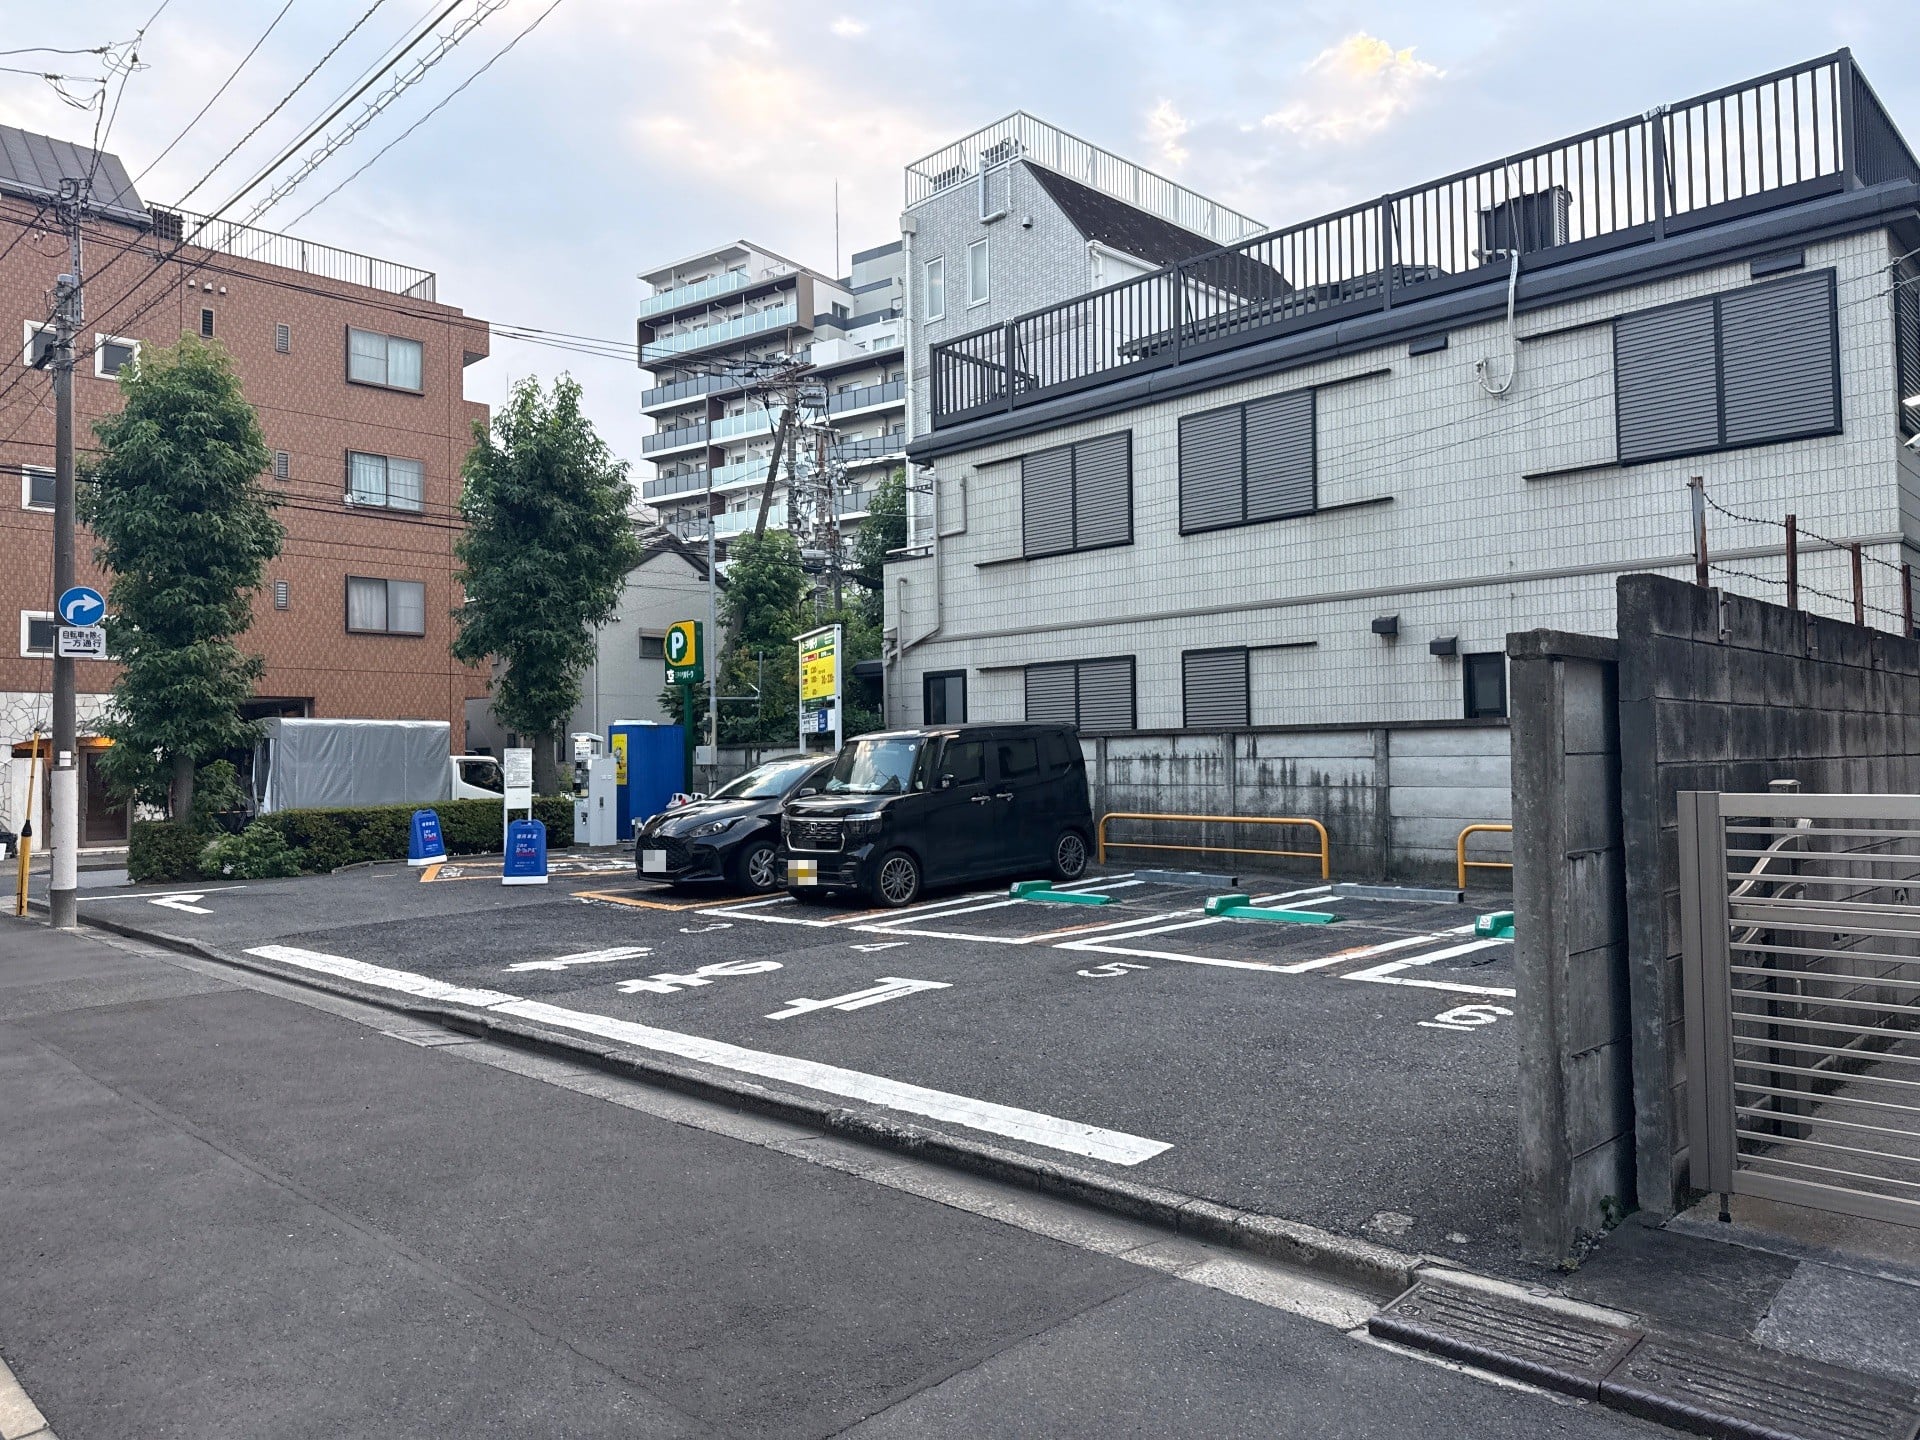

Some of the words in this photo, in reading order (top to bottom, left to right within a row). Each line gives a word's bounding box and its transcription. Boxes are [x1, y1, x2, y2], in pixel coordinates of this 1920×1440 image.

[63, 631, 102, 640] 自転車を除く
[63, 639, 102, 647] 一方通行
[671, 632, 684, 659] P
[848, 942, 910, 952] 4
[1076, 962, 1151, 977] 5
[1434, 1004, 1514, 1025] 6
